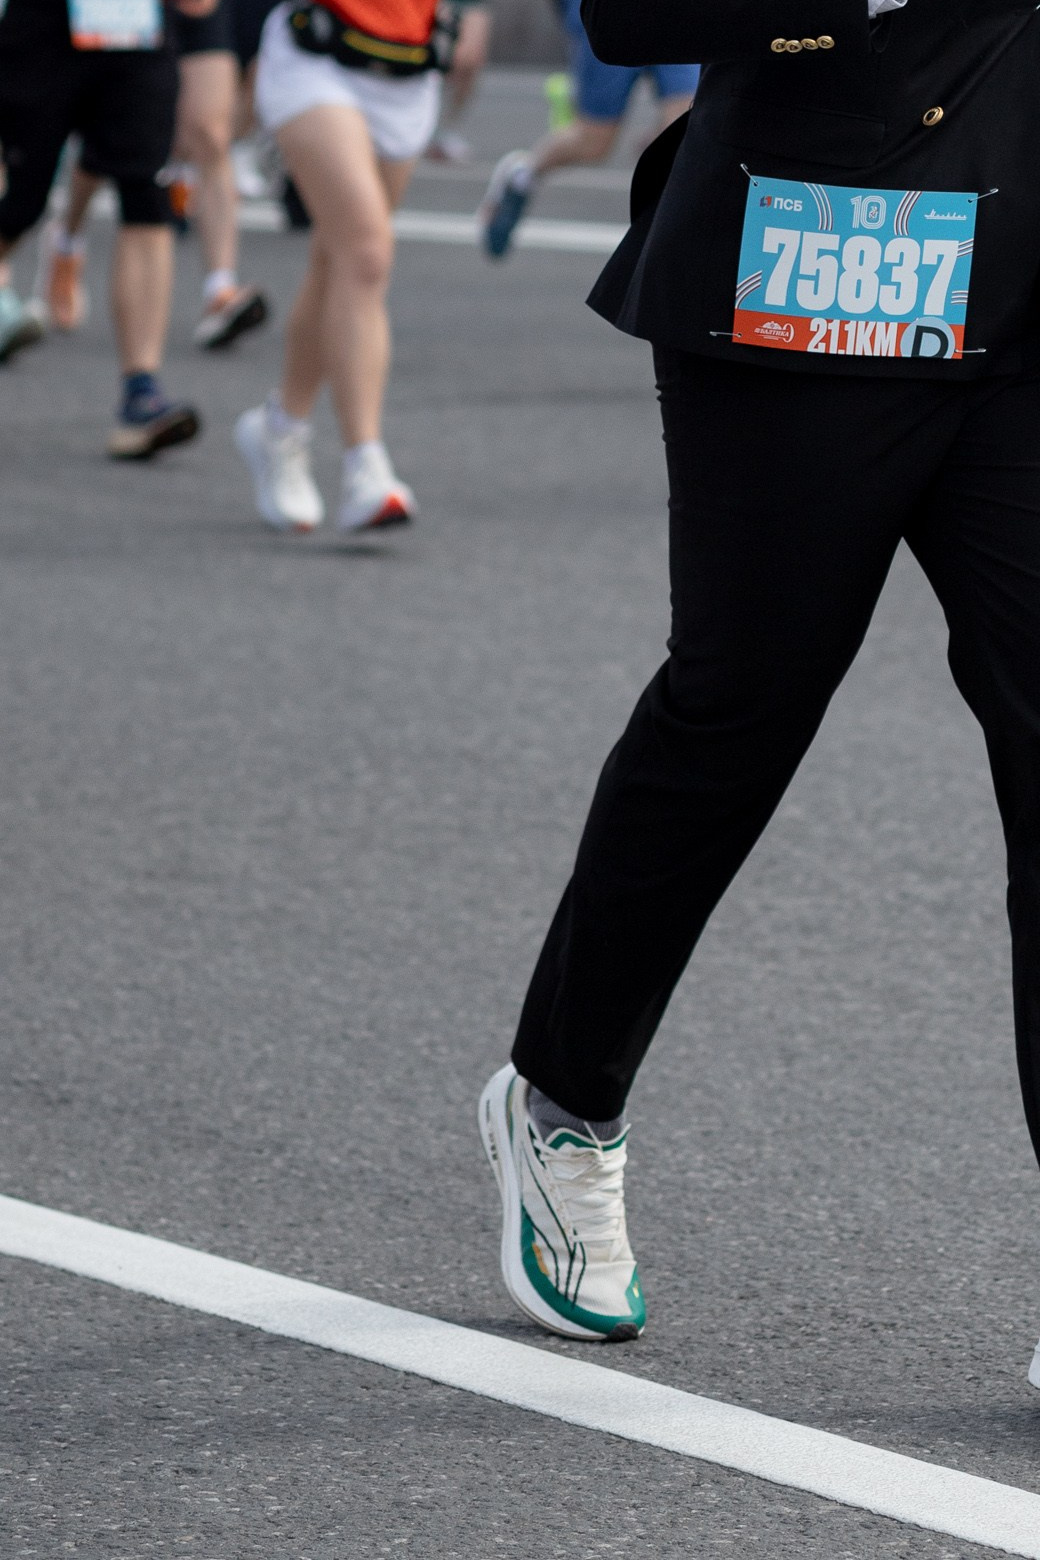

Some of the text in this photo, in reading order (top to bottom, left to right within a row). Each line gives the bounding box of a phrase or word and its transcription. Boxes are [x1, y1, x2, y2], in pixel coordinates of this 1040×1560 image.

[773, 196, 803, 212] ПСБ
[850, 195, 887, 230] 10
[762, 226, 960, 316] 75837
[806, 317, 899, 357] 21.1KM
[911, 324, 949, 359] D
